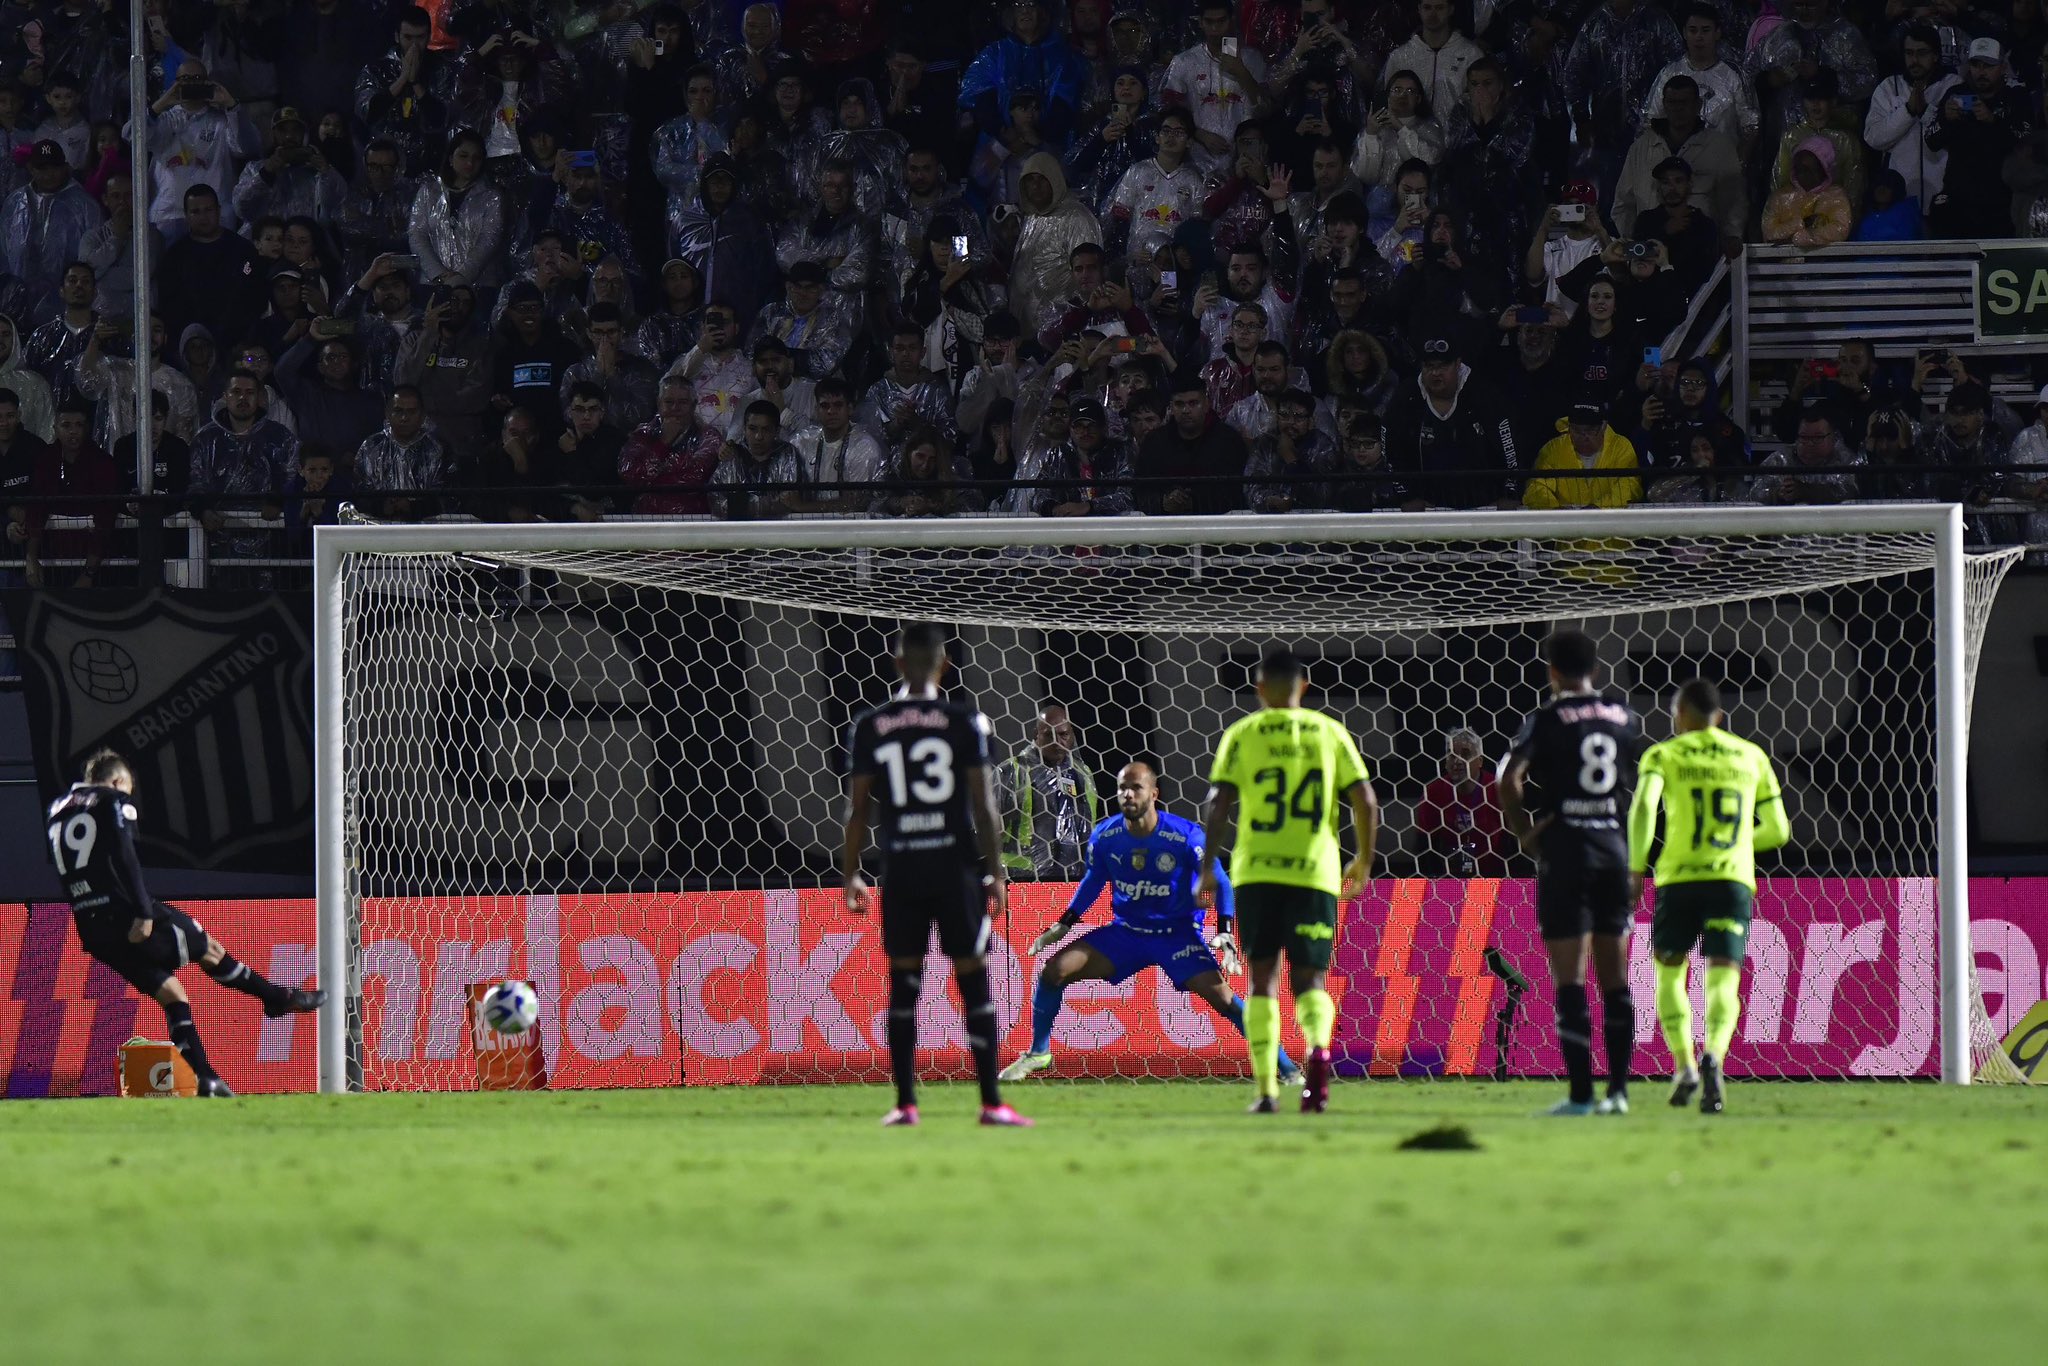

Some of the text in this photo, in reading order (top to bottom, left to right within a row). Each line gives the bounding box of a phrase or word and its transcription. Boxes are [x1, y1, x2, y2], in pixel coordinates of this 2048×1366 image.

[1987, 268, 2048, 316] SA
[125, 631, 281, 751] BRAGANTINO
[873, 737, 956, 808] 13
[1578, 732, 1618, 794] 8
[1251, 766, 1324, 833] 34
[1690, 788, 1742, 850] 19
[48, 811, 98, 876] 19
[1115, 879, 1171, 901] crefisa
[1630, 877, 2048, 1075] mrJa
